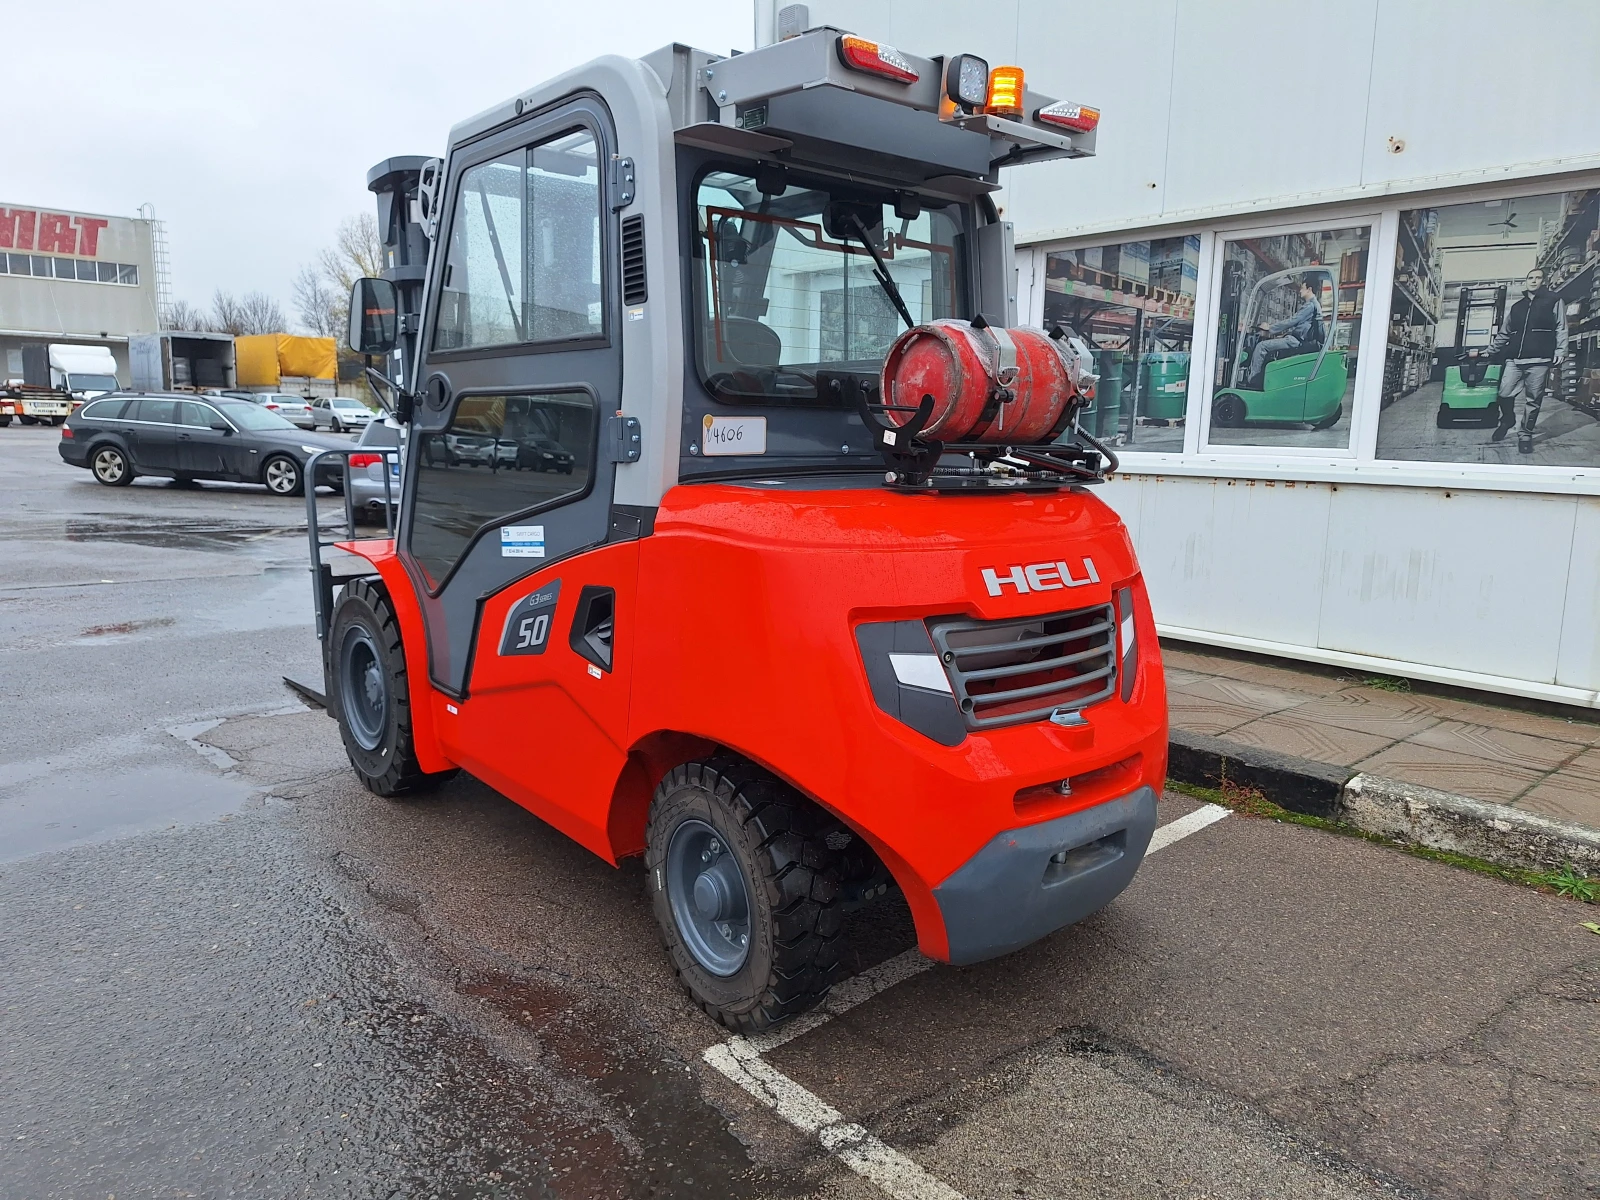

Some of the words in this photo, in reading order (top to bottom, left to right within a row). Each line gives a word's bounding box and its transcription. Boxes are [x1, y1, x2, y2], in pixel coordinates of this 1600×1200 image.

[980, 557, 1101, 597] HELI
[540, 593, 553, 603] SERIES
[516, 614, 549, 649] 50
